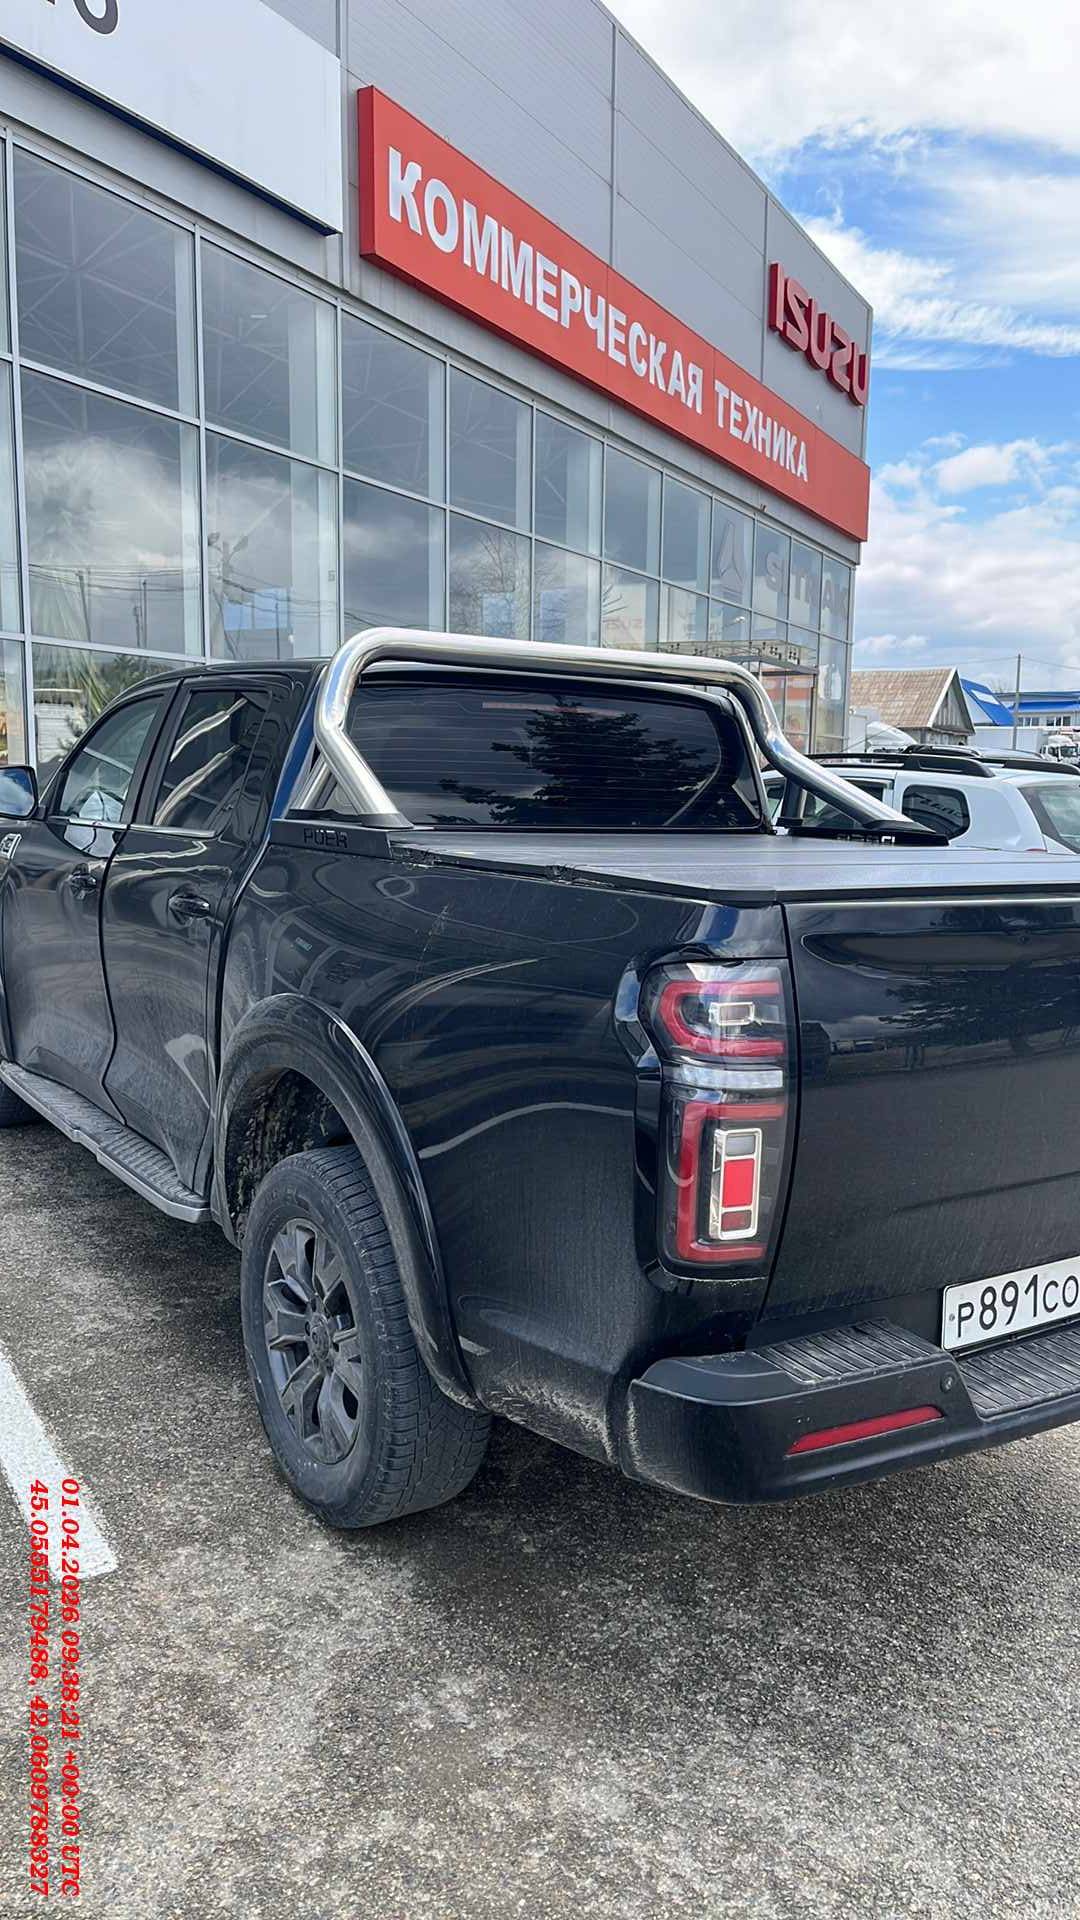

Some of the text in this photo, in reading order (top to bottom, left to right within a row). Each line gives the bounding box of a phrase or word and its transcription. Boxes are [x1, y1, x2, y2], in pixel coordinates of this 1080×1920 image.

[388, 145, 809, 482] КОММЕРЧЕСКАЯ ТЕХНИКА
[769, 261, 868, 406] ISUZU
